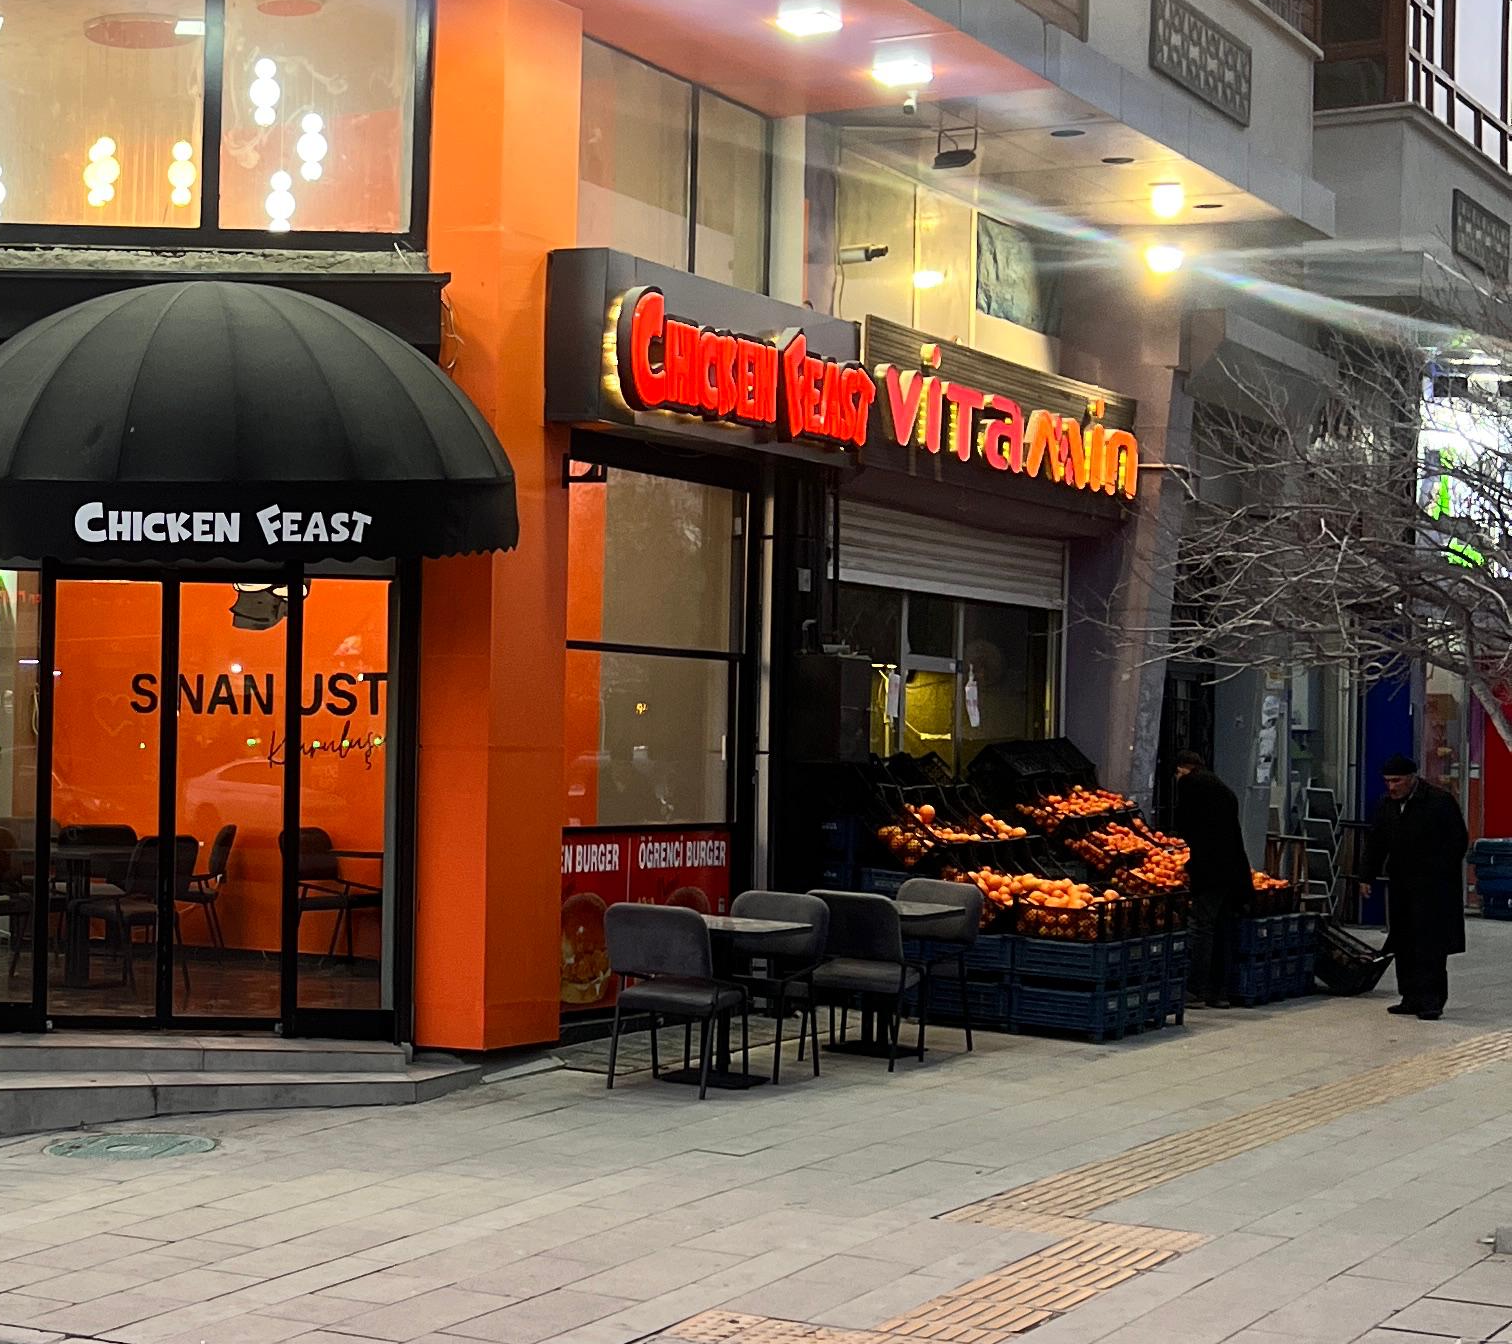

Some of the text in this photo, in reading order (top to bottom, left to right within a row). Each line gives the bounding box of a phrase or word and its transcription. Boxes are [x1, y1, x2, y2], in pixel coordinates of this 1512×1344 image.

[629, 290, 877, 447] CHICKEN FEAST
[74, 501, 373, 546] CHICKEN FEAST
[129, 672, 275, 716] SNAN
[575, 843, 620, 873] BURGER
[638, 834, 727, 870] ÖĞRENCİ BURGER
